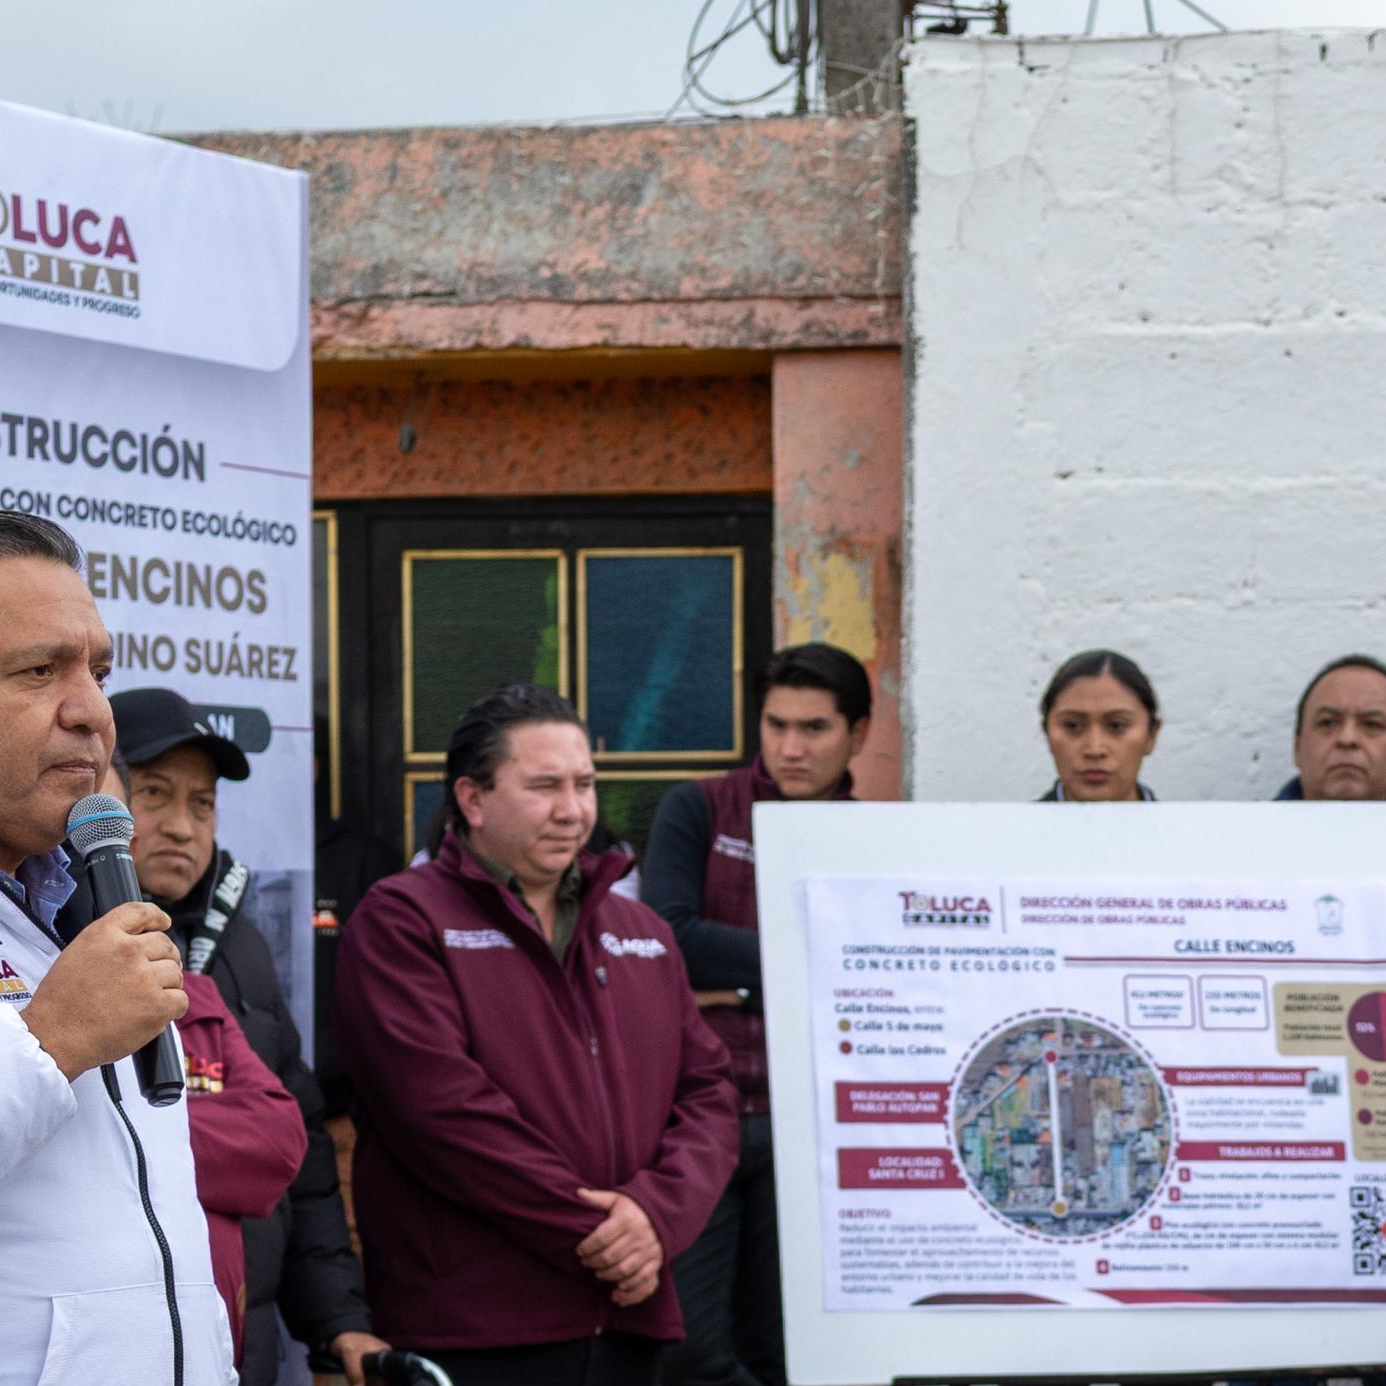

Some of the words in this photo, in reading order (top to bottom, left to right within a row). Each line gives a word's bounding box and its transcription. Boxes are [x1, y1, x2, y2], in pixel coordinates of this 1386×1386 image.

[73, 295, 80, 308] Y
[82, 297, 141, 319] PROGRESO
[0, 488, 51, 516] CON
[57, 494, 177, 531] CONCRETO
[181, 509, 297, 547] ECOLÓGICO
[87, 552, 267, 615] ENCINOS
[110, 632, 176, 673] INO
[184, 630, 298, 682] SUÁREZ
[898, 891, 993, 913] TOLUCA
[1020, 895, 1092, 909] DIRECCIÓN
[1095, 897, 1154, 909] GENERAL
[1159, 898, 1174, 909] DE
[1177, 898, 1221, 910] OBRAS
[1226, 896, 1288, 911] PÚBLICAS
[1021, 912, 1079, 924] DIRECCIÓN
[1081, 914, 1094, 924] DE
[1097, 914, 1133, 925] OBRAS
[842, 944, 925, 956] CONSTRUCCIÓN
[927, 946, 941, 956] DE
[1032, 948, 1056, 957] CON
[1174, 939, 1222, 954] CALLE
[1226, 939, 1296, 955] ENCINOS
[842, 959, 941, 972] CONCRETO
[950, 957, 1056, 973] ECOLÓGICO
[835, 1003, 863, 1014] Calle
[855, 1020, 883, 1032] Calle
[898, 1021, 910, 1032] de
[913, 1023, 944, 1034] mayo
[857, 1044, 886, 1056] Calle
[889, 1044, 905, 1056] los
[908, 1043, 946, 1056] Cedros
